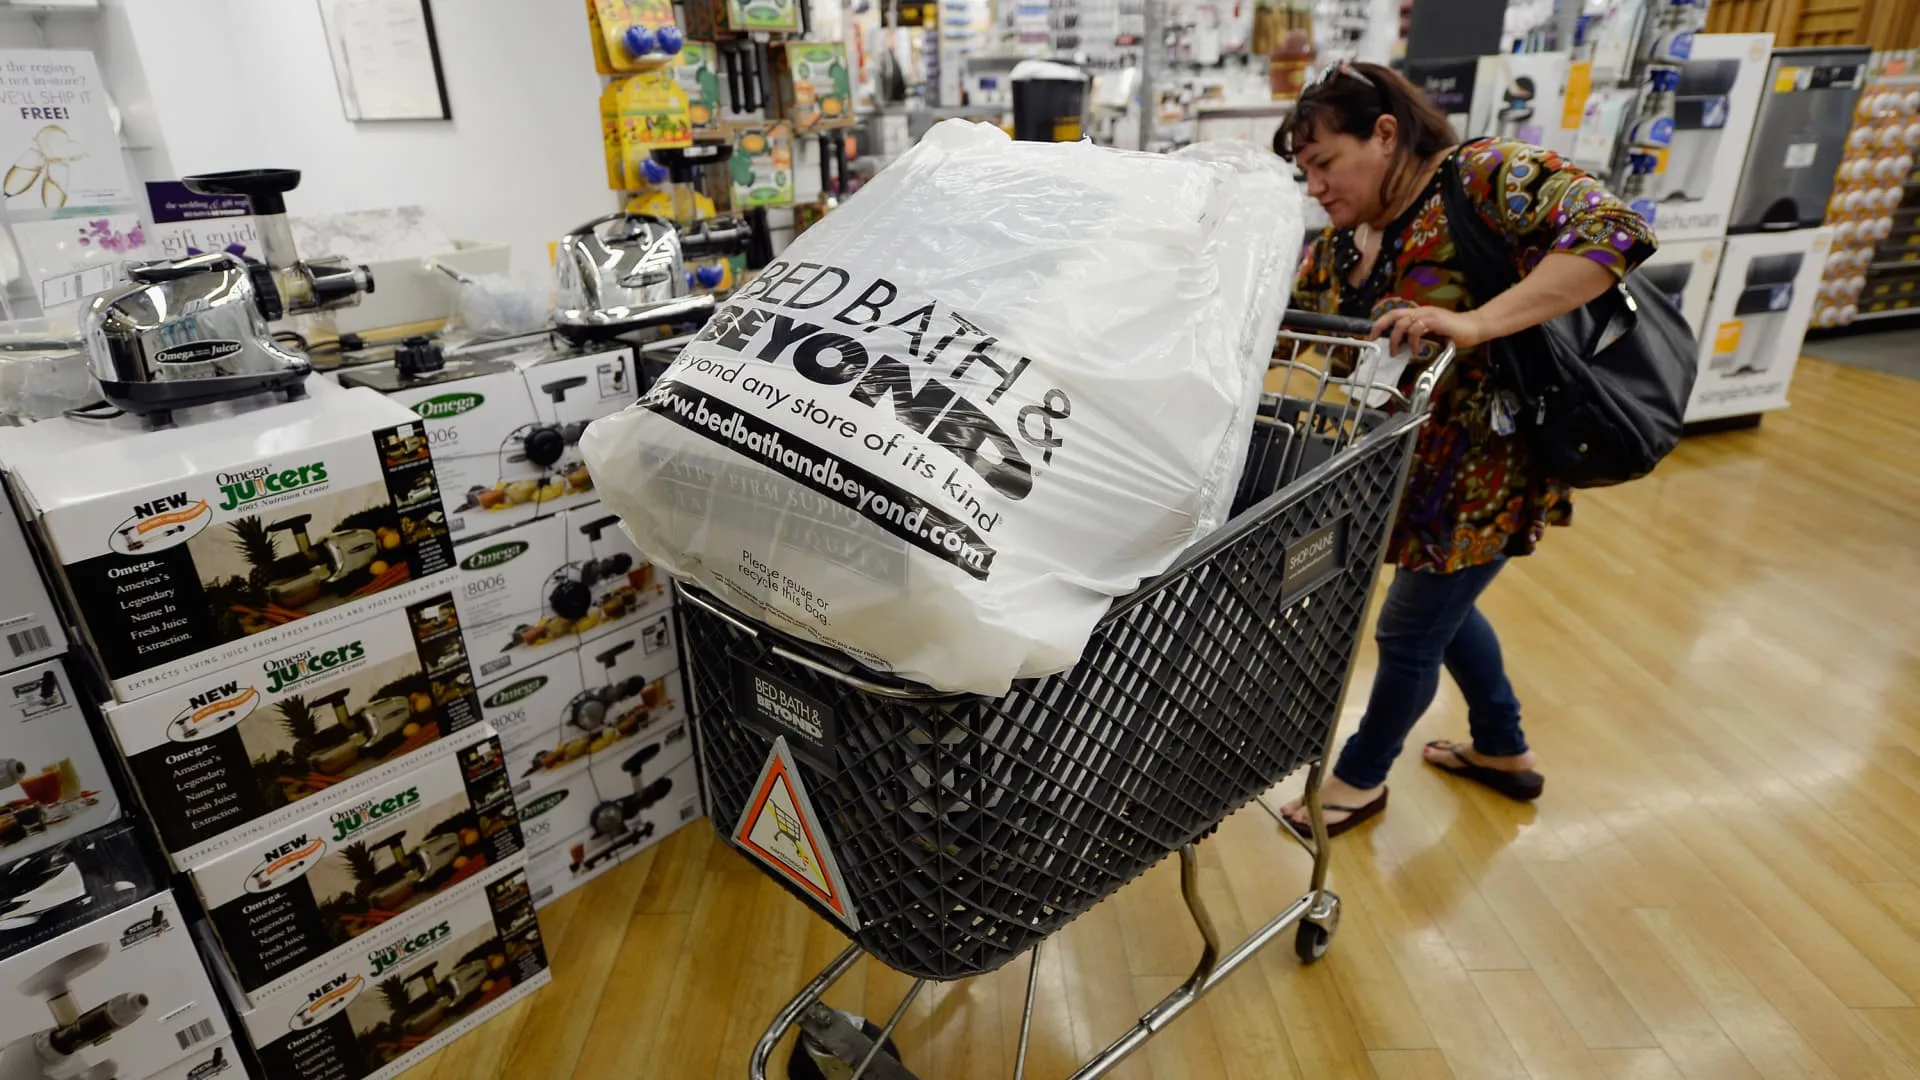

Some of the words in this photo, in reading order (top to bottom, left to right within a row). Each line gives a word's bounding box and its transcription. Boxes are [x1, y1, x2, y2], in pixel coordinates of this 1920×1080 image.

[39, 90, 75, 105] SHIP
[20, 106, 70, 120] FREE!
[161, 227, 198, 256] gift
[156, 350, 195, 362] Omega
[211, 343, 240, 357] Juicer
[735, 261, 850, 310] BED
[833, 278, 1033, 406] BATH
[1016, 388, 1072, 467] &
[417, 396, 477, 417] Omega
[693, 304, 1033, 501] BEYOND
[427, 425, 458, 444] 006
[742, 376, 791, 410] any
[791, 398, 857, 438] store
[863, 433, 905, 457] of
[901, 445, 937, 480] its
[942, 467, 999, 533] kind
[215, 464, 270, 487] Omega
[728, 473, 780, 501] FIRM
[134, 491, 188, 520] NEW
[468, 545, 521, 568] Omega
[1288, 547, 1310, 571] SHOP
[116, 573, 170, 595] America's
[467, 574, 506, 597] 8006
[742, 549, 780, 579] Please
[782, 574, 814, 601] reuse
[816, 597, 830, 612] or
[120, 588, 175, 611] Legendary
[738, 562, 780, 593] recycle
[782, 585, 802, 608] this
[805, 600, 832, 627] bag.
[130, 608, 163, 624] Name
[164, 604, 177, 613] In
[130, 624, 160, 641] Fresh
[161, 617, 189, 631] Juice
[137, 632, 193, 655] Extraction.
[262, 649, 313, 674] Omega
[127, 667, 181, 692] EXTRACTS
[189, 680, 239, 709] NEW
[754, 676, 778, 700] BED
[779, 689, 811, 721] BATH
[811, 709, 823, 729] &
[756, 692, 824, 739] BEYOND
[176, 767, 226, 792] Legendary
[264, 832, 308, 863] NEW
[308, 972, 348, 1002] NEW
